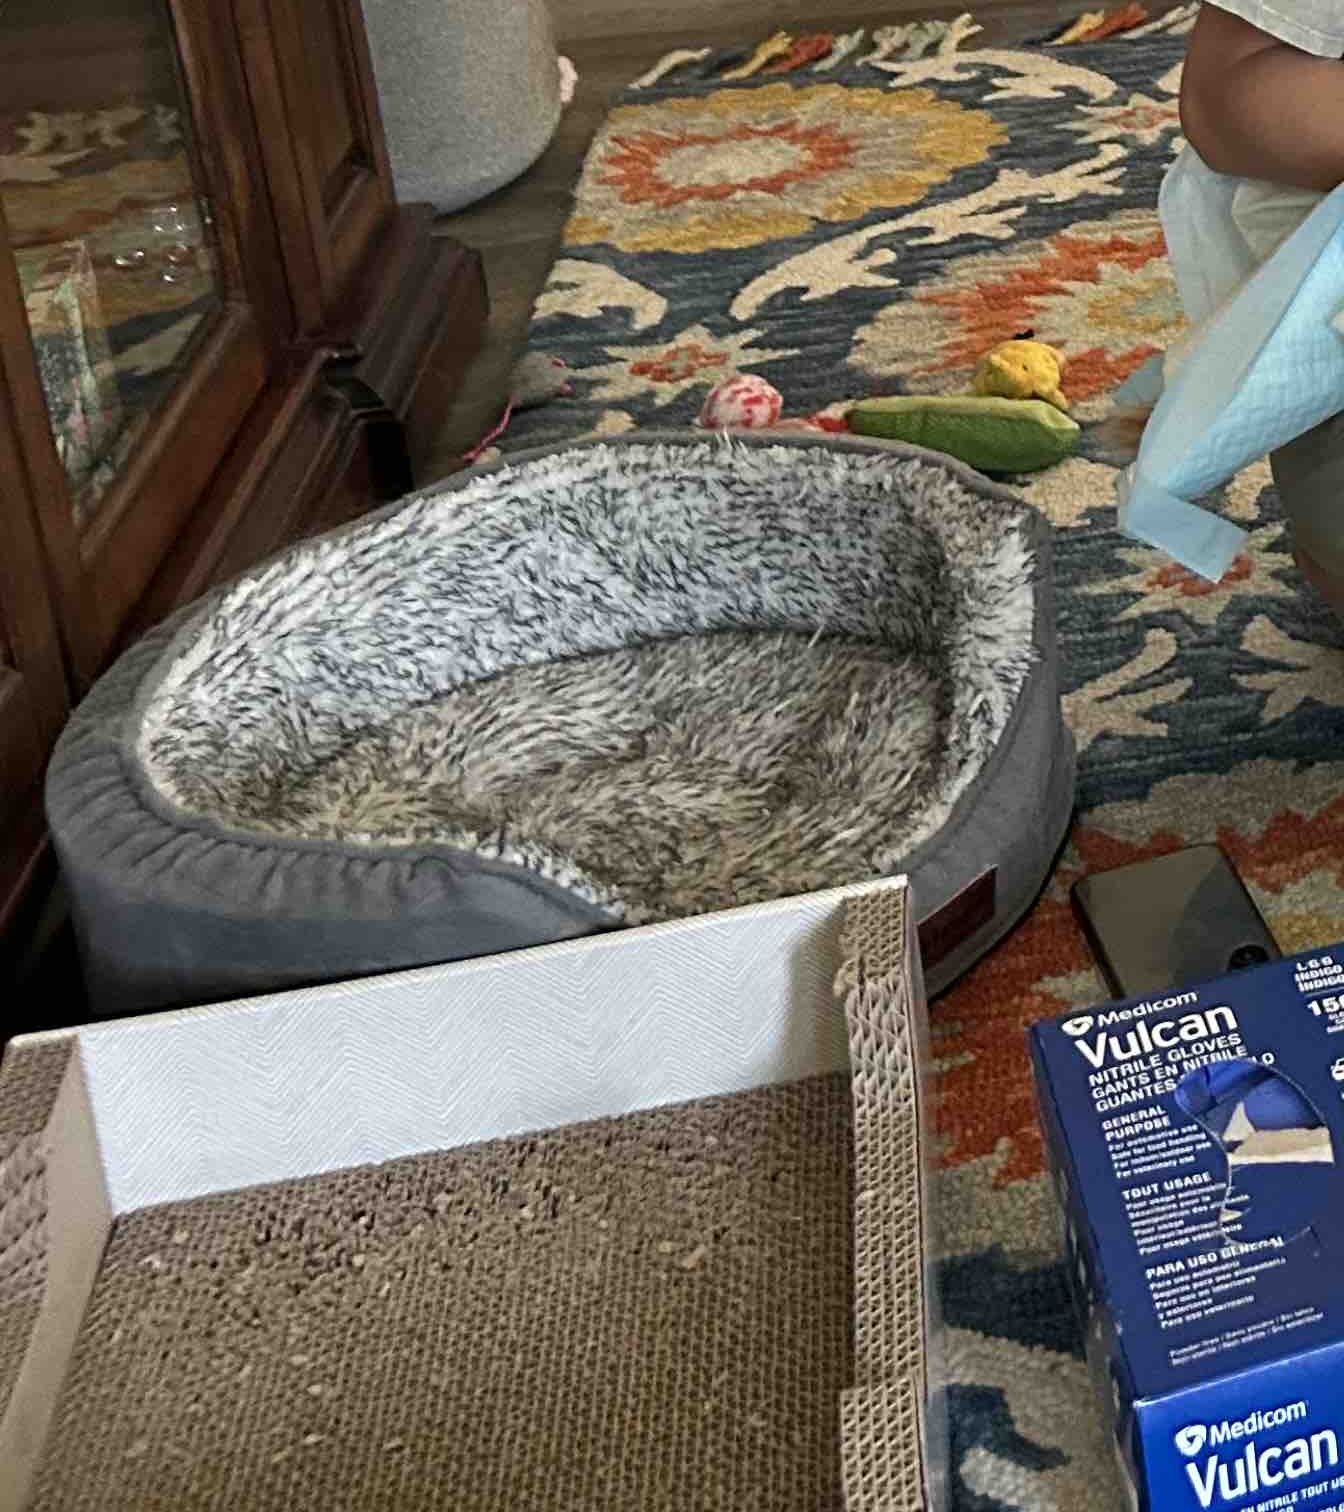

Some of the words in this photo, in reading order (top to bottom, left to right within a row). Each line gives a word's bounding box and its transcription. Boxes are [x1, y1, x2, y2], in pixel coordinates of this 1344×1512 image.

[1294, 964, 1343, 982] INDIGO
[1098, 991, 1198, 1027] Medicom
[1074, 1005, 1238, 1068] Vulcan
[1089, 1054, 1162, 1086] NITRILE
[1167, 1033, 1242, 1062] GLOVES
[1092, 1071, 1150, 1099] GANTS
[1155, 1065, 1178, 1080] EN
[1183, 1045, 1248, 1074] NITRILE
[1095, 1079, 1177, 1112] GUANTES
[1102, 1105, 1166, 1130] GENERAL
[1105, 1115, 1171, 1141] PURPOSE
[1122, 1182, 1159, 1201] TOUT
[1164, 1171, 1211, 1192] USAGE
[1146, 1260, 1185, 1278] PARA
[1188, 1252, 1218, 1268] USO
[1209, 1400, 1306, 1446] Medicom
[1186, 1429, 1338, 1508] Vulcan
[1257, 1491, 1298, 1511] NITRILE
[1301, 1481, 1328, 1499] TOUT
